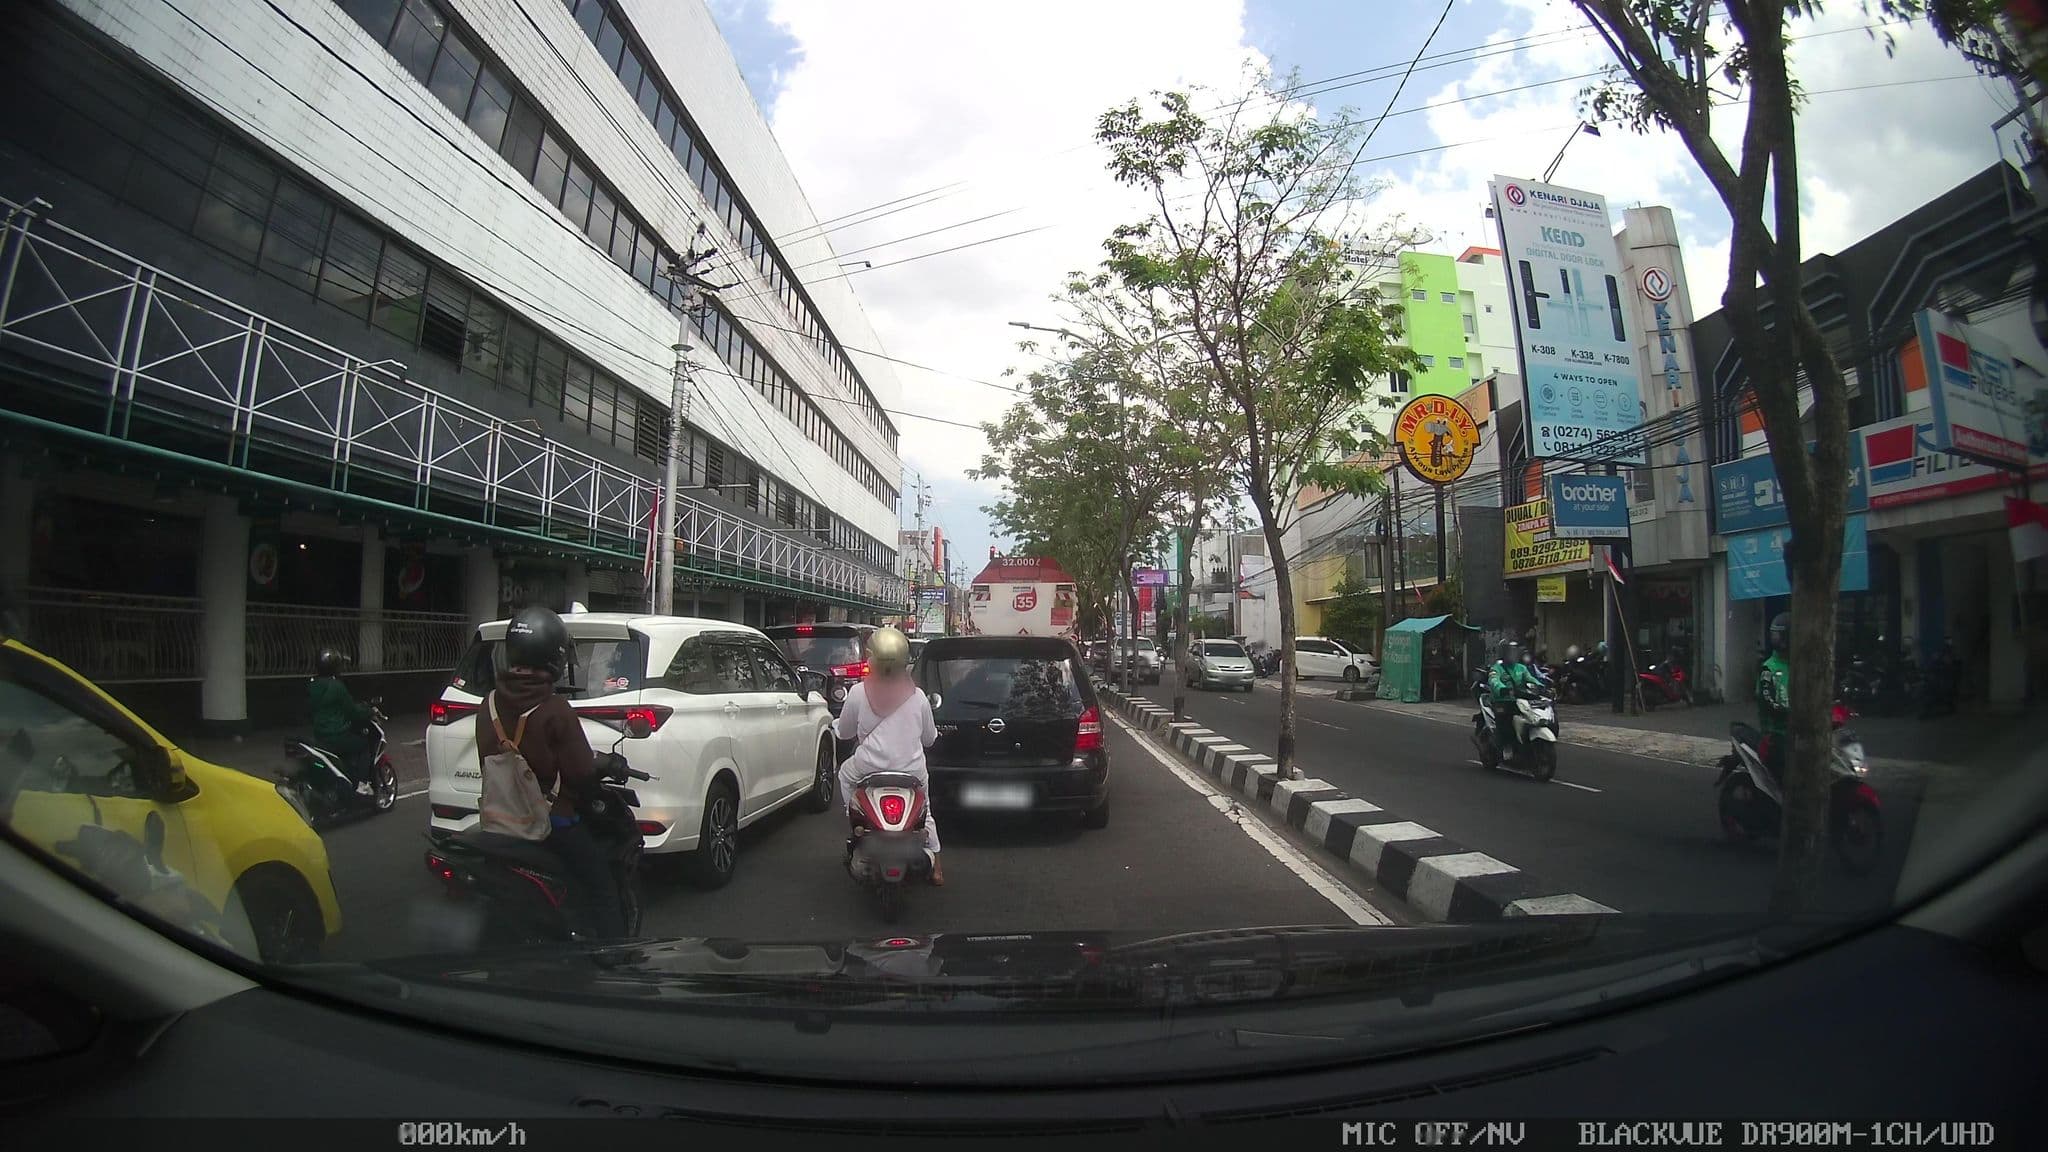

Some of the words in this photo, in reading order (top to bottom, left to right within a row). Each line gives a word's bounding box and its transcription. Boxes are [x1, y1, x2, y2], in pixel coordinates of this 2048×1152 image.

[1529, 190, 1568, 204] KENARI
[1570, 198, 1601, 210] DJAJA
[1526, 247, 1559, 260] DIGITAL
[1560, 254, 1583, 264] DOOR
[1531, 344, 1556, 356] K-308
[1570, 349, 1594, 361] K-338
[1603, 353, 1630, 366] K-7800
[1653, 301, 1682, 408] KENARI
[1560, 373, 1583, 382] WAYS
[1597, 377, 1618, 387] OPEN
[1400, 402, 1429, 436] MR
[1553, 425, 1592, 441] (0274)
[1561, 482, 1617, 502] brother
[1506, 504, 1533, 523] DIJUAL
[1573, 503, 1579, 511] at
[1580, 503, 1596, 513] your
[1596, 503, 1610, 512] side
